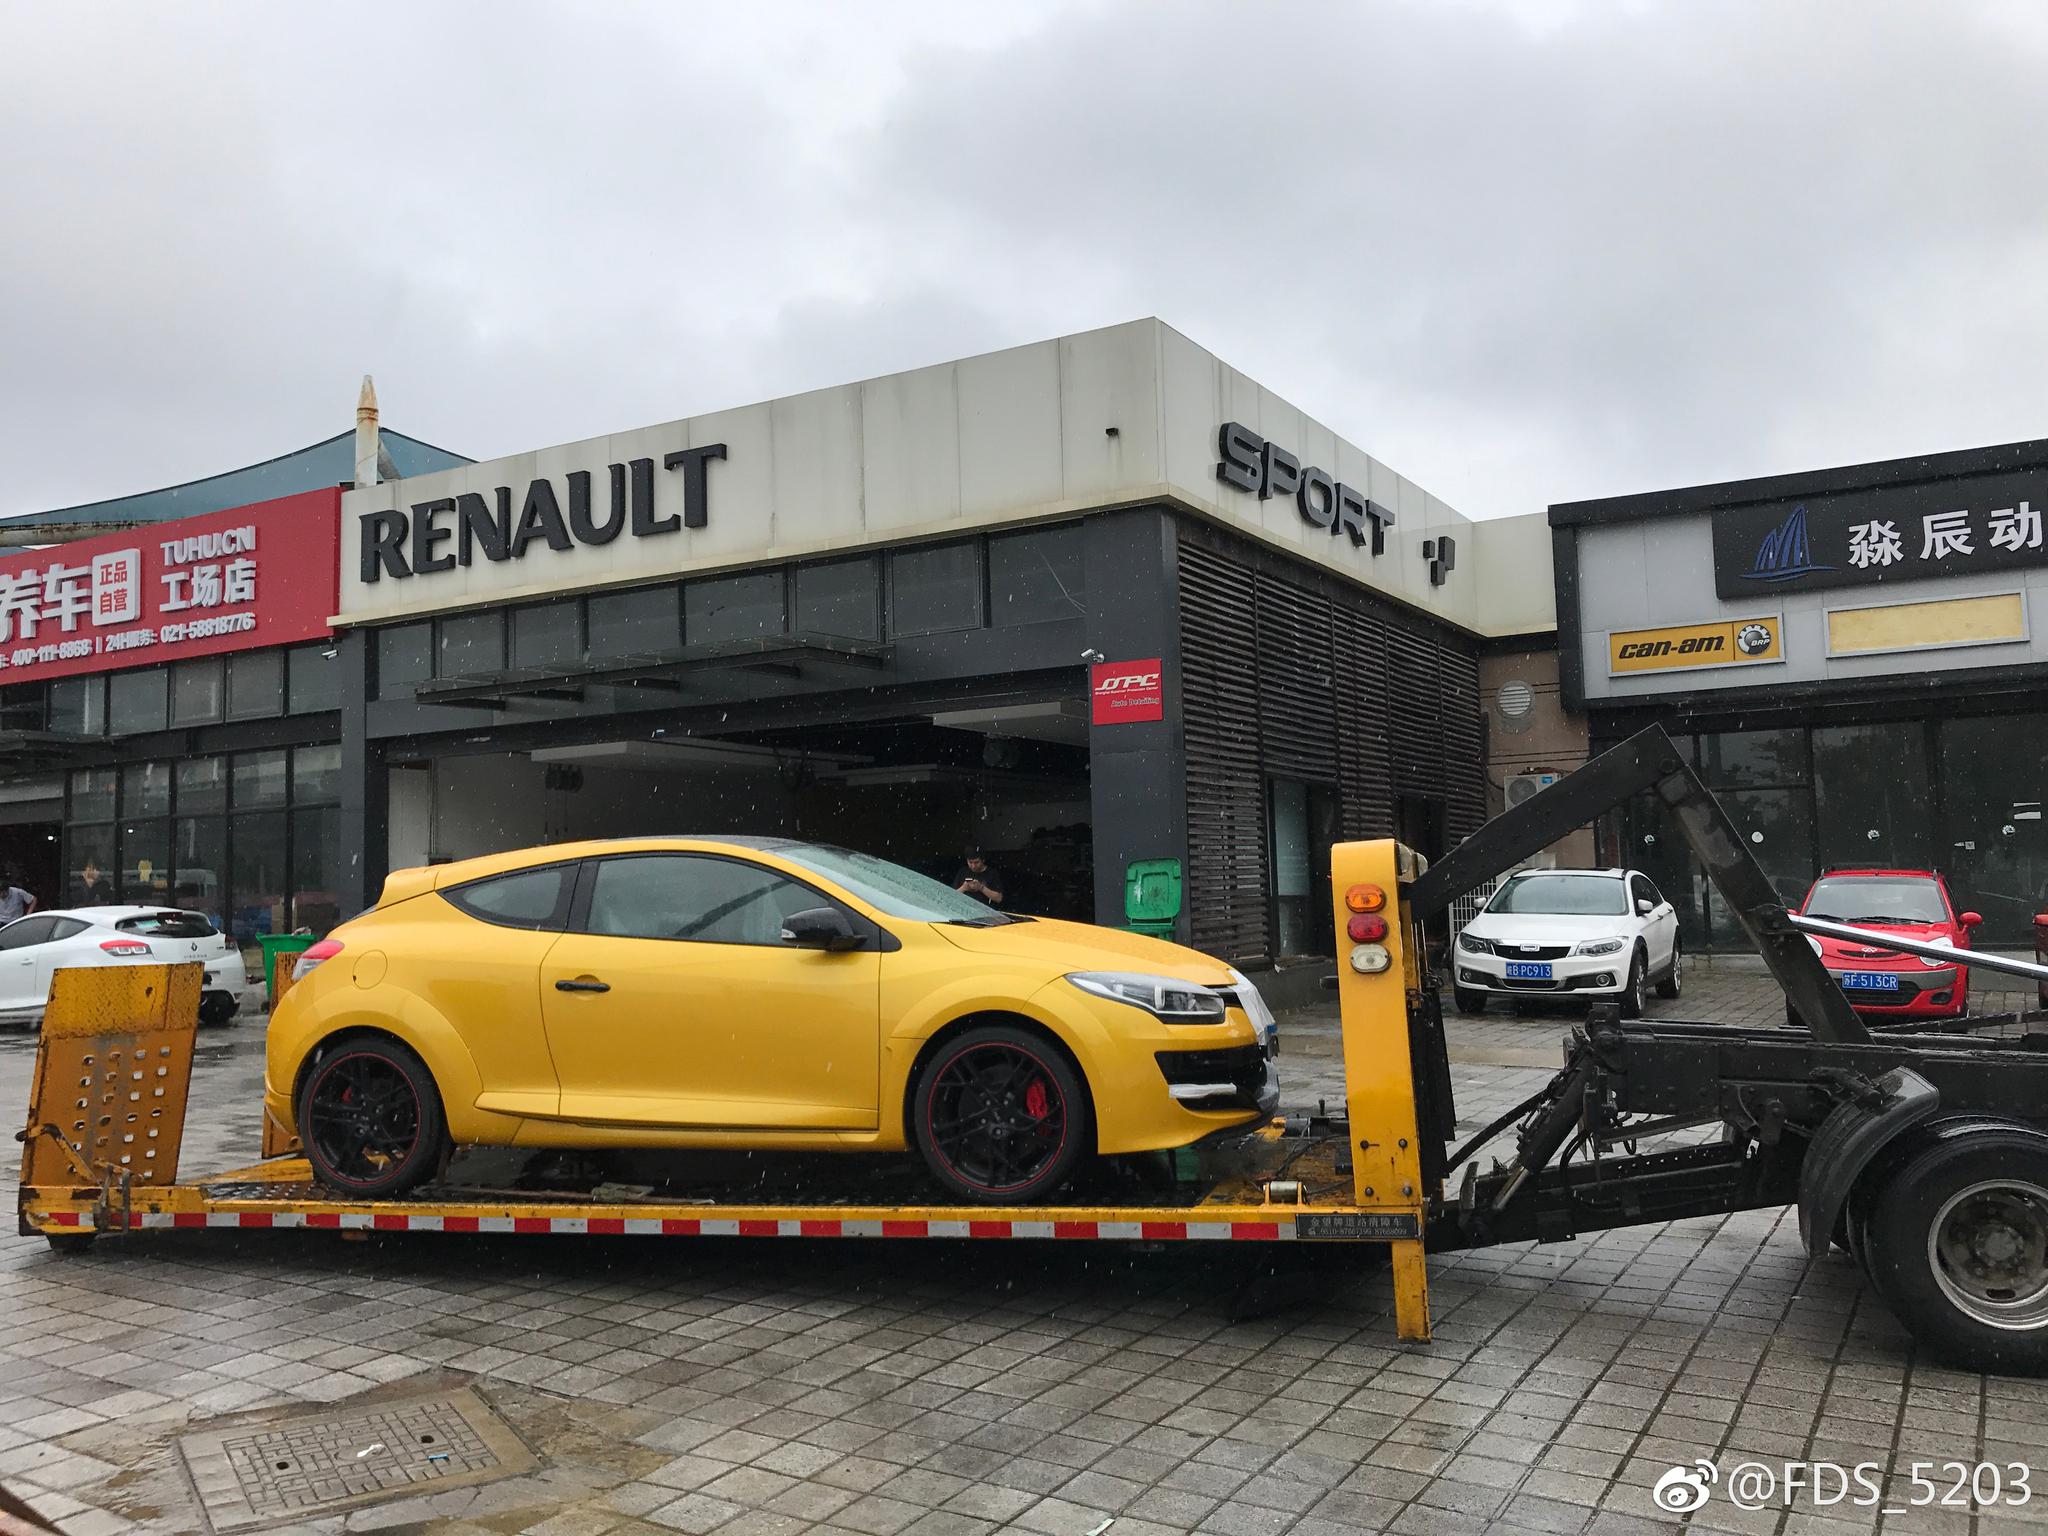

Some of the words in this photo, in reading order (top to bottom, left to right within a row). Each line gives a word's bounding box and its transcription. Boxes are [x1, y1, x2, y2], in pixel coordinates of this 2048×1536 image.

[1216, 421, 1395, 556] SPORT
[359, 443, 727, 583] RENAULT
[160, 526, 256, 566] TUHU.CN
[99, 560, 128, 587] 正品
[159, 558, 256, 612] 工场店
[99, 588, 128, 616] 自营
[1618, 635, 1724, 660] can-am
[1750, 638, 1771, 647] BRP
[1111, 700, 1128, 708] Auto
[1129, 697, 1160, 705] Detailing
